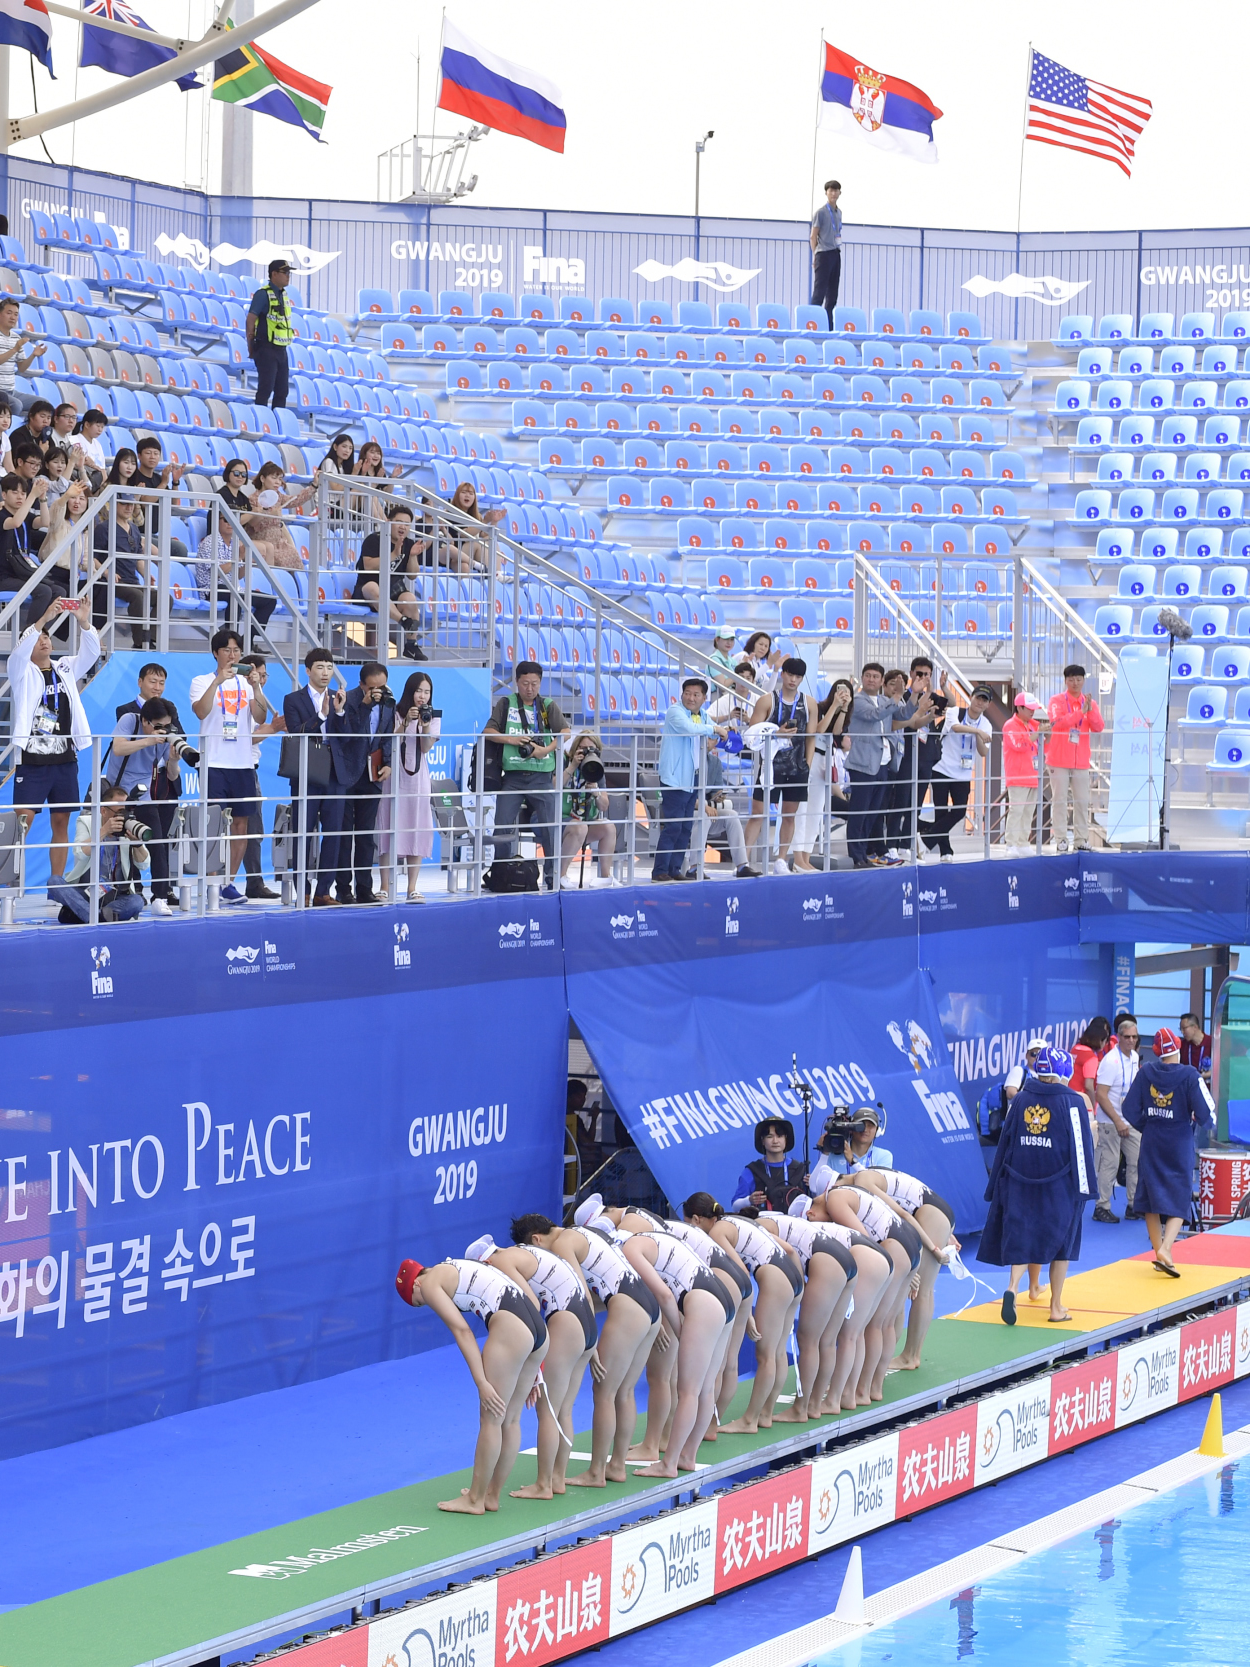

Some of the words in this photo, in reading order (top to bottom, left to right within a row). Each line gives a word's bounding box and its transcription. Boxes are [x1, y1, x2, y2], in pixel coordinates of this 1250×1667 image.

[390, 240, 503, 264] GWANGJU
[523, 245, 586, 284] Fina
[454, 268, 503, 288] 2019
[1140, 264, 1250, 285] GWANGJU
[1206, 289, 1250, 307] 2019
[394, 945, 411, 966] Fina
[91, 970, 113, 995] Fina
[911, 1079, 971, 1134] Fina
[1148, 1107, 1174, 1119] RUSSIA
[409, 1103, 508, 1158] GWANGJU
[1020, 1136, 1052, 1148] RUSSIA
[47, 1134, 165, 1216] INTO
[182, 1101, 311, 1192] PEACE
[434, 1159, 478, 1205] 2019
[1231, 1161, 1241, 1198] SPRING
[79, 1235, 151, 1323] 물결
[161, 1215, 256, 1302] 속으로
[1151, 1346, 1177, 1374] Myrtha
[1182, 1330, 1232, 1390] 农夫山泉
[1150, 1373, 1169, 1398] Pools
[1017, 1396, 1047, 1432] Myrtha
[1053, 1376, 1113, 1439] 农夫山泉
[1016, 1423, 1039, 1448] Pools
[857, 1454, 894, 1494] Myrtha
[902, 1430, 971, 1503] 农夫山泉
[856, 1486, 884, 1518] Pools
[286, 1523, 429, 1573] Malmsten
[669, 1524, 712, 1570] Myrtha
[722, 1497, 804, 1577] 农夫山泉
[668, 1560, 699, 1592] Pools
[439, 1607, 490, 1652] Myrtha
[503, 1571, 603, 1664] 农夫山泉
